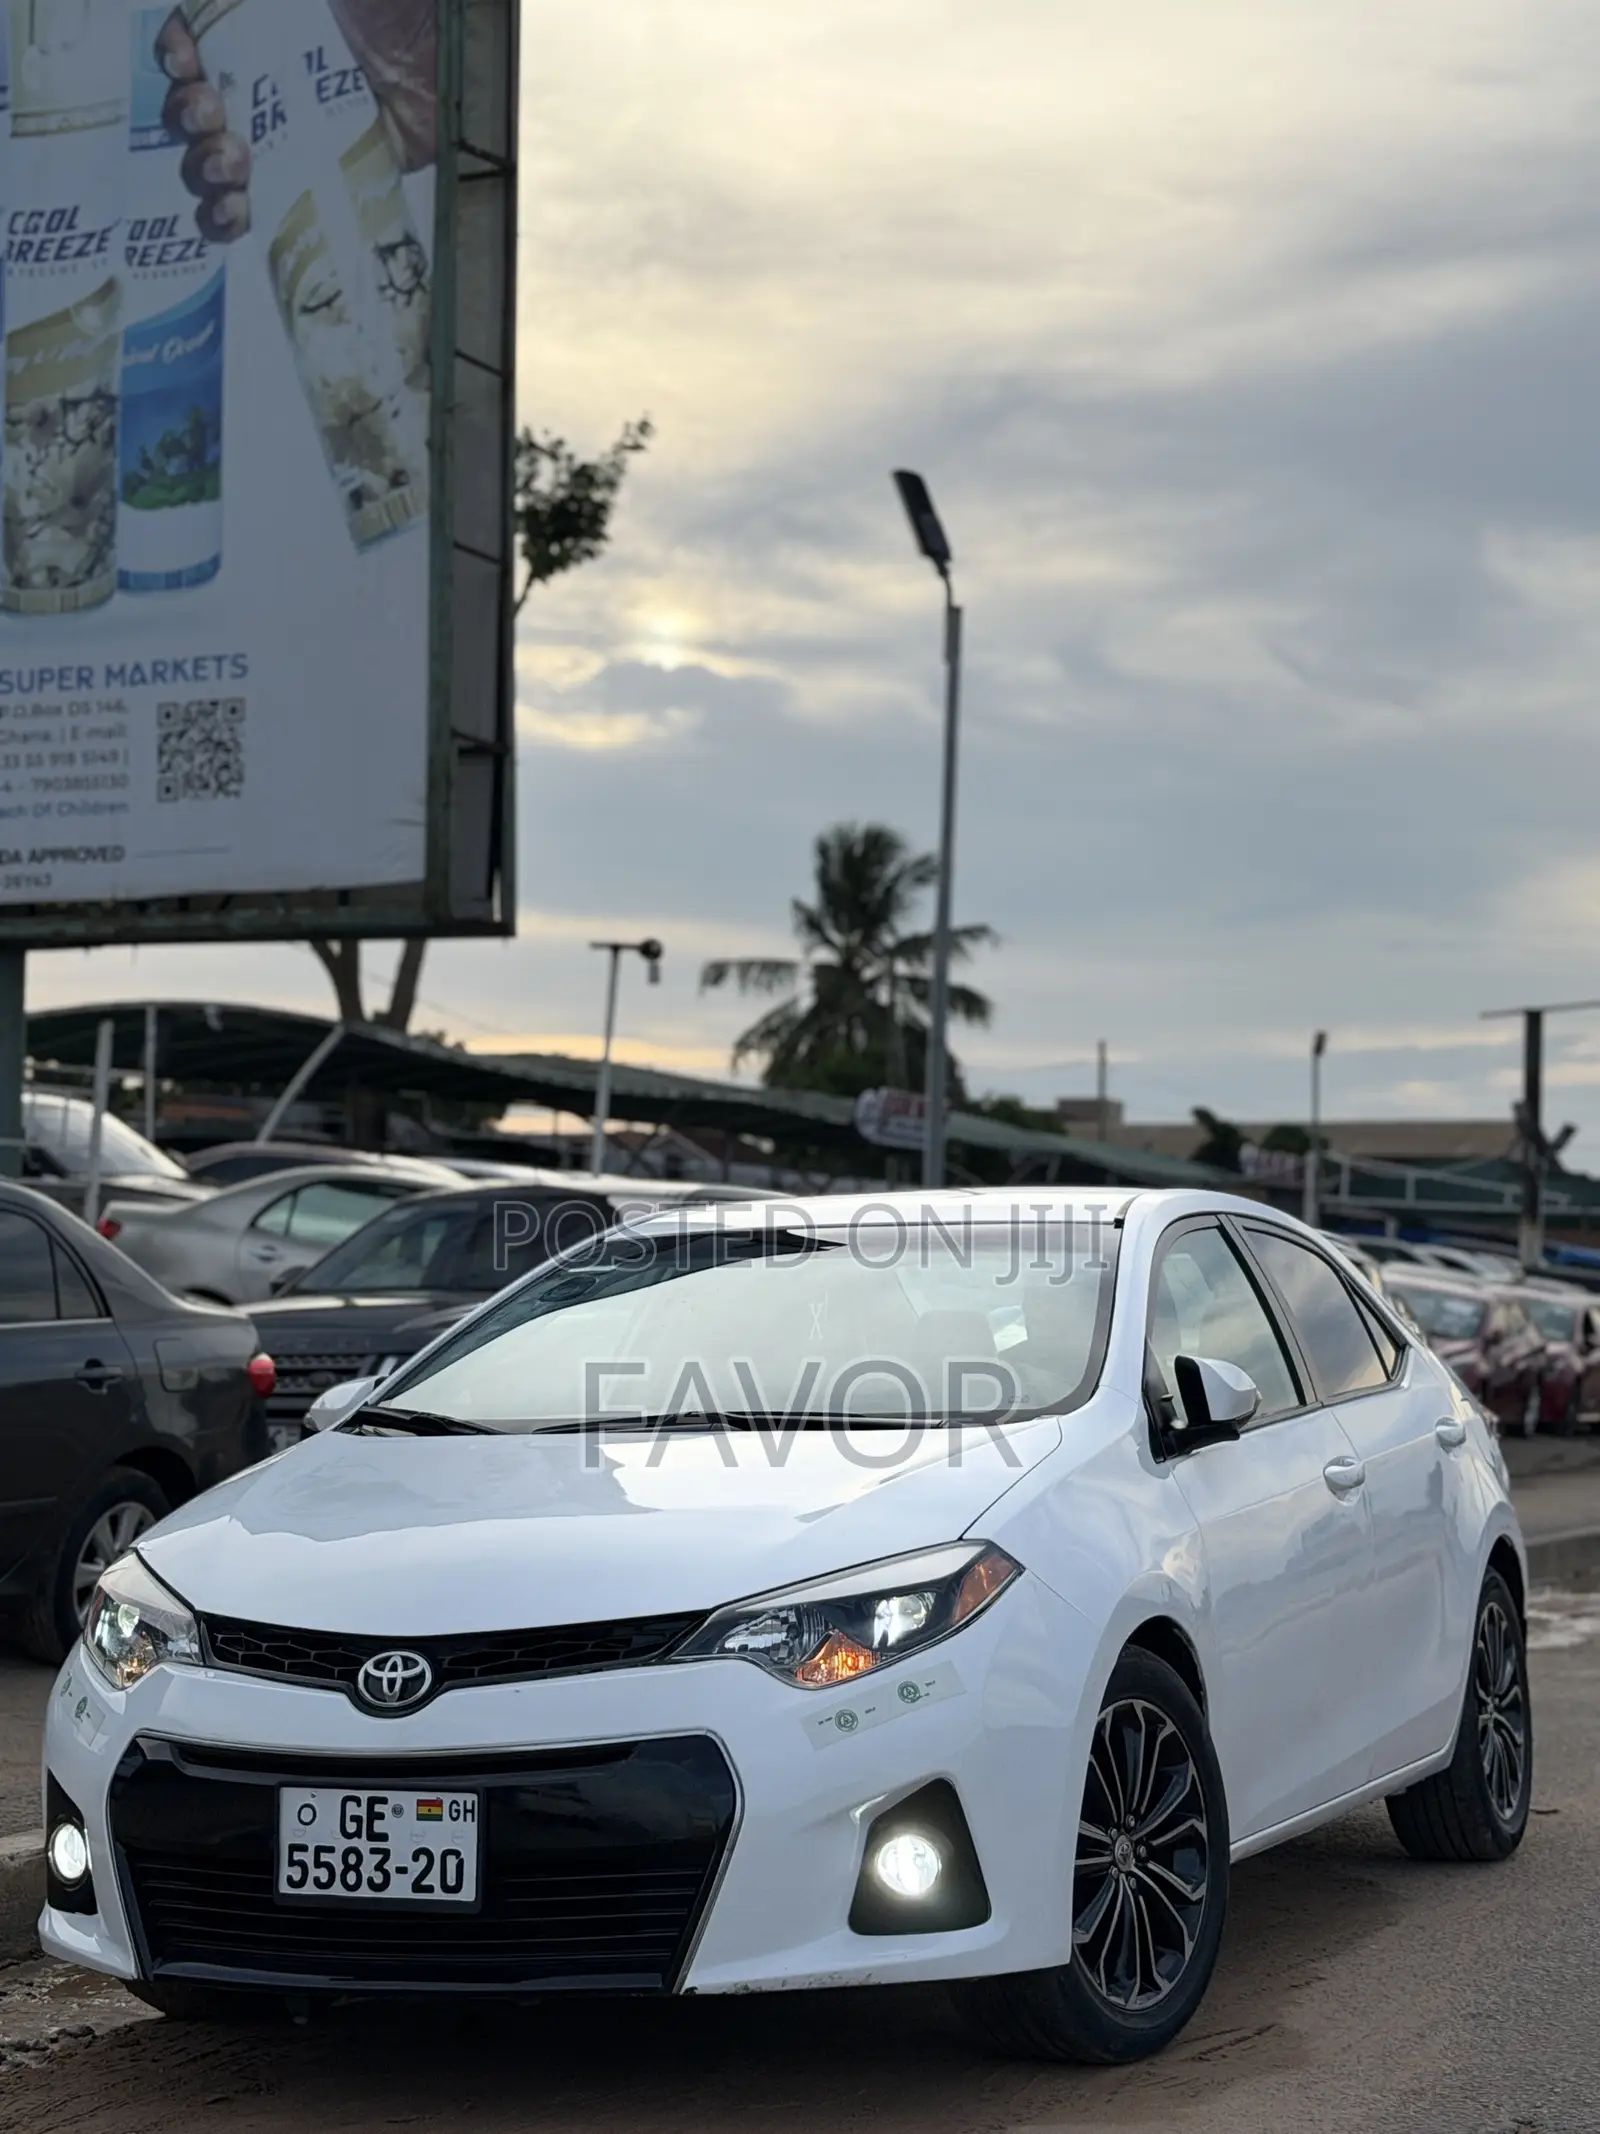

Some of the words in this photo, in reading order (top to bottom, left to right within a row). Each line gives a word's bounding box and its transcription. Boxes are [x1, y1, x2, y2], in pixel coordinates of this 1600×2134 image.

[0, 665, 95, 697] SUPER
[104, 653, 250, 690] MARKETS
[27, 844, 127, 867] APPROVED
[340, 1795, 389, 1842] GE
[448, 1799, 476, 1823] GH
[286, 1843, 465, 1894] 5583-20
